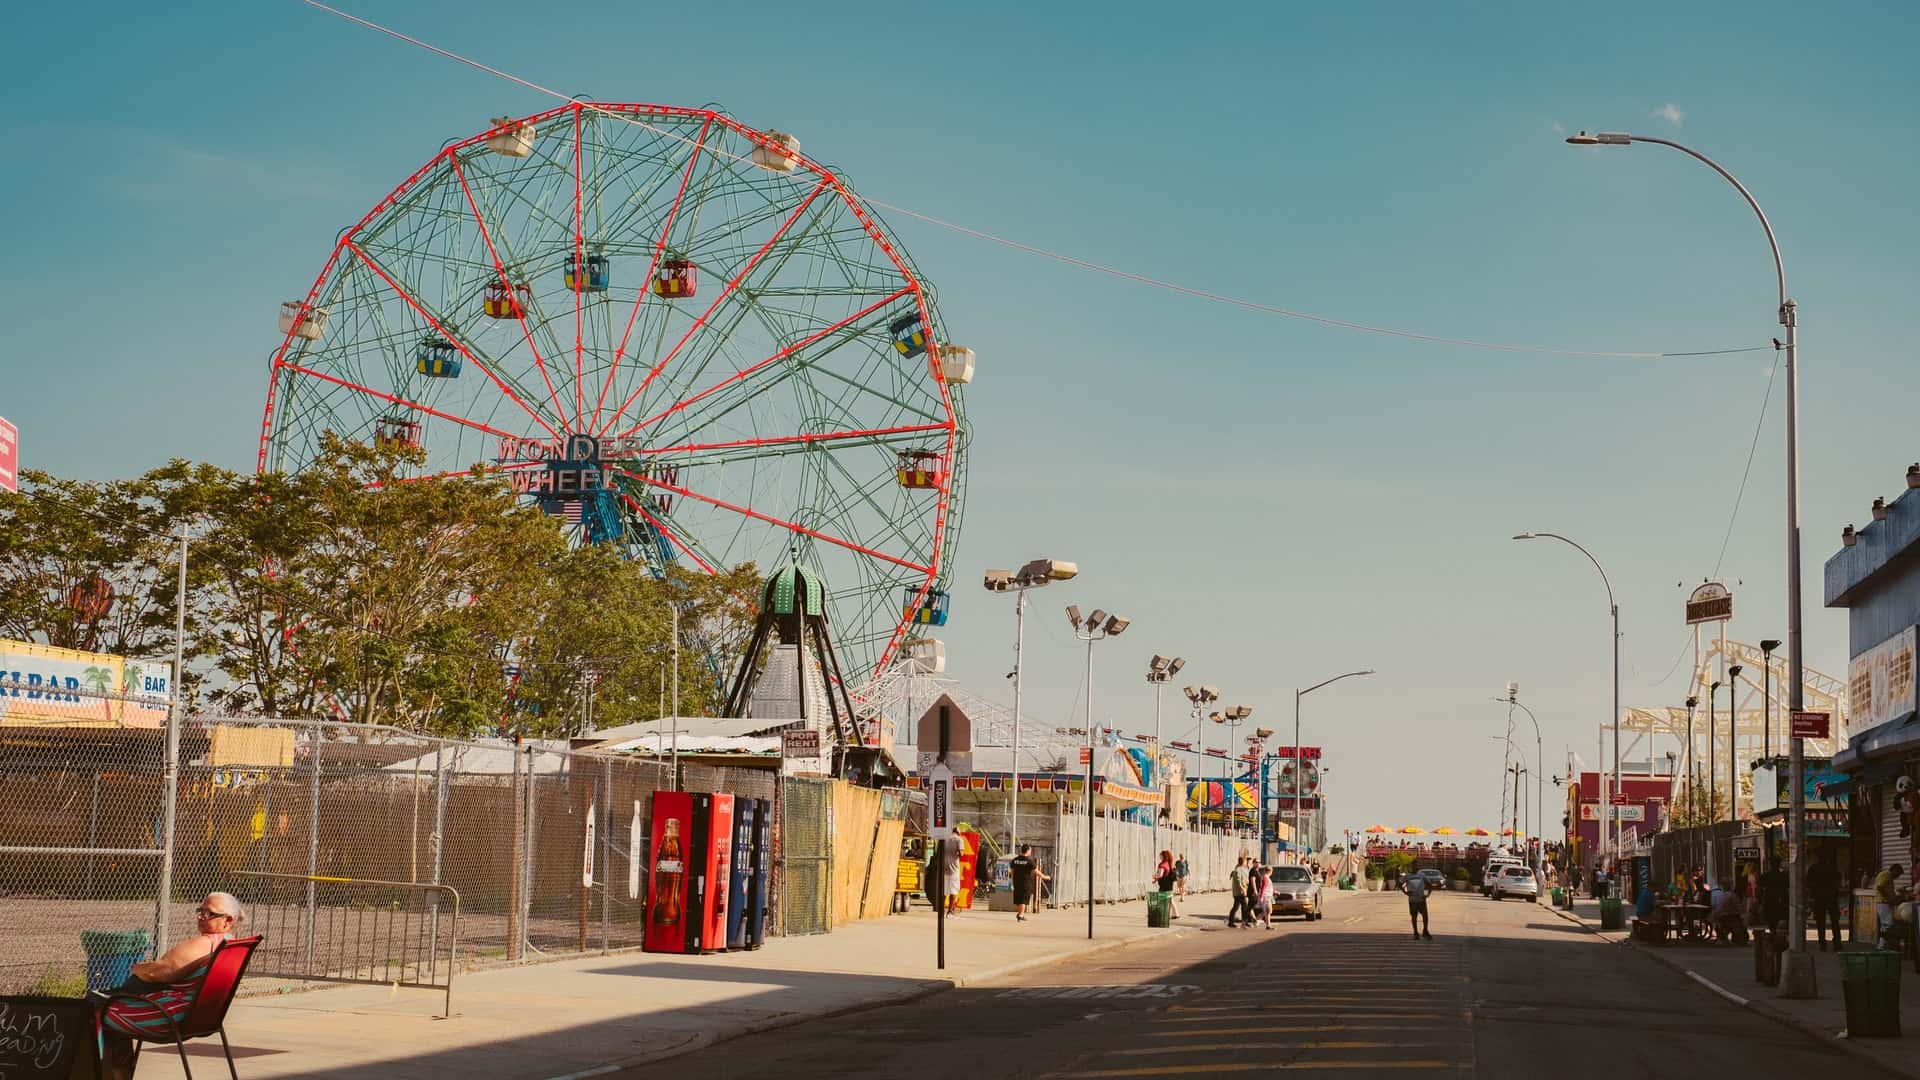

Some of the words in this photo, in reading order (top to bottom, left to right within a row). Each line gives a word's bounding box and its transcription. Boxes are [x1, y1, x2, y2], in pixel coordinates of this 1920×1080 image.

[497, 437, 641, 461] WONDER
[509, 469, 617, 493] WHEEL
[27, 673, 80, 703] BAR
[144, 676, 166, 692] BAR
